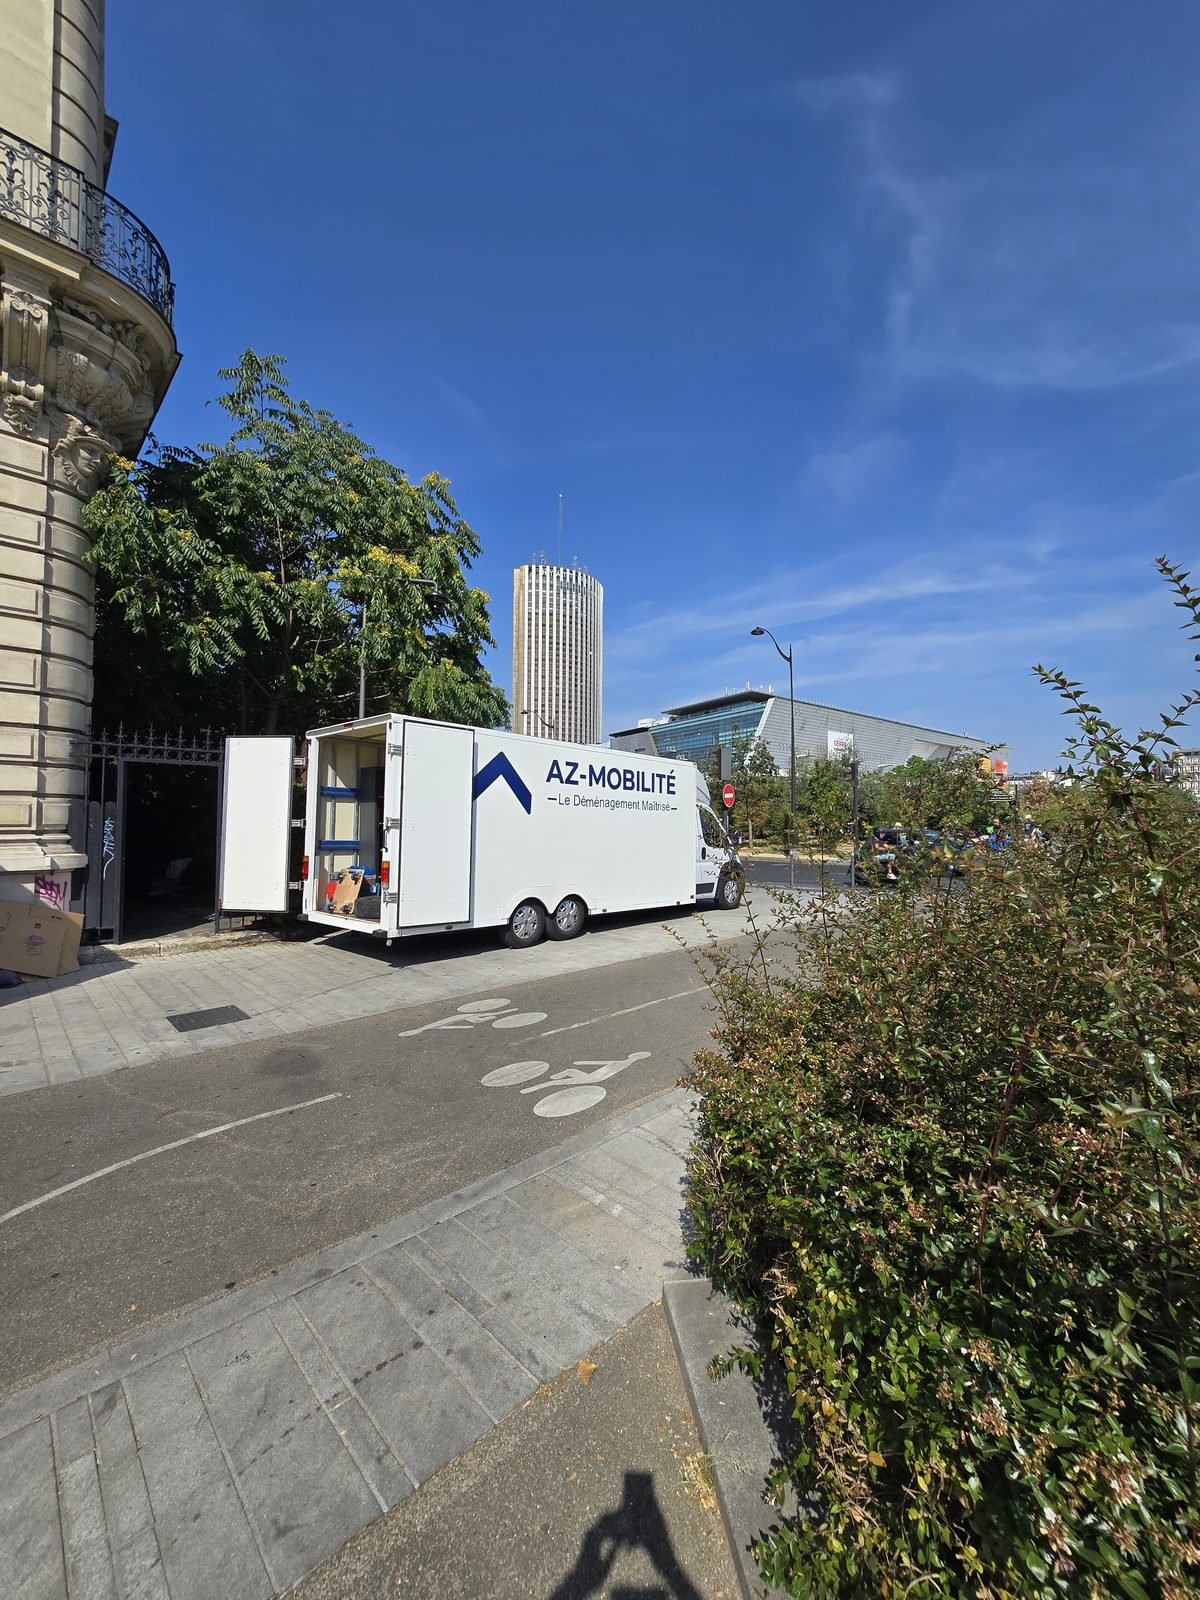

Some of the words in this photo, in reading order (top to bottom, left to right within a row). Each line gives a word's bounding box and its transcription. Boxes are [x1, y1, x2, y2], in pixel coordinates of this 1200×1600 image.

[546, 759, 676, 795] AZ-MOBILITÉ
[558, 794, 571, 806] Le
[573, 794, 640, 811] Déménagement
[641, 800, 670, 812] Maîtrisé
